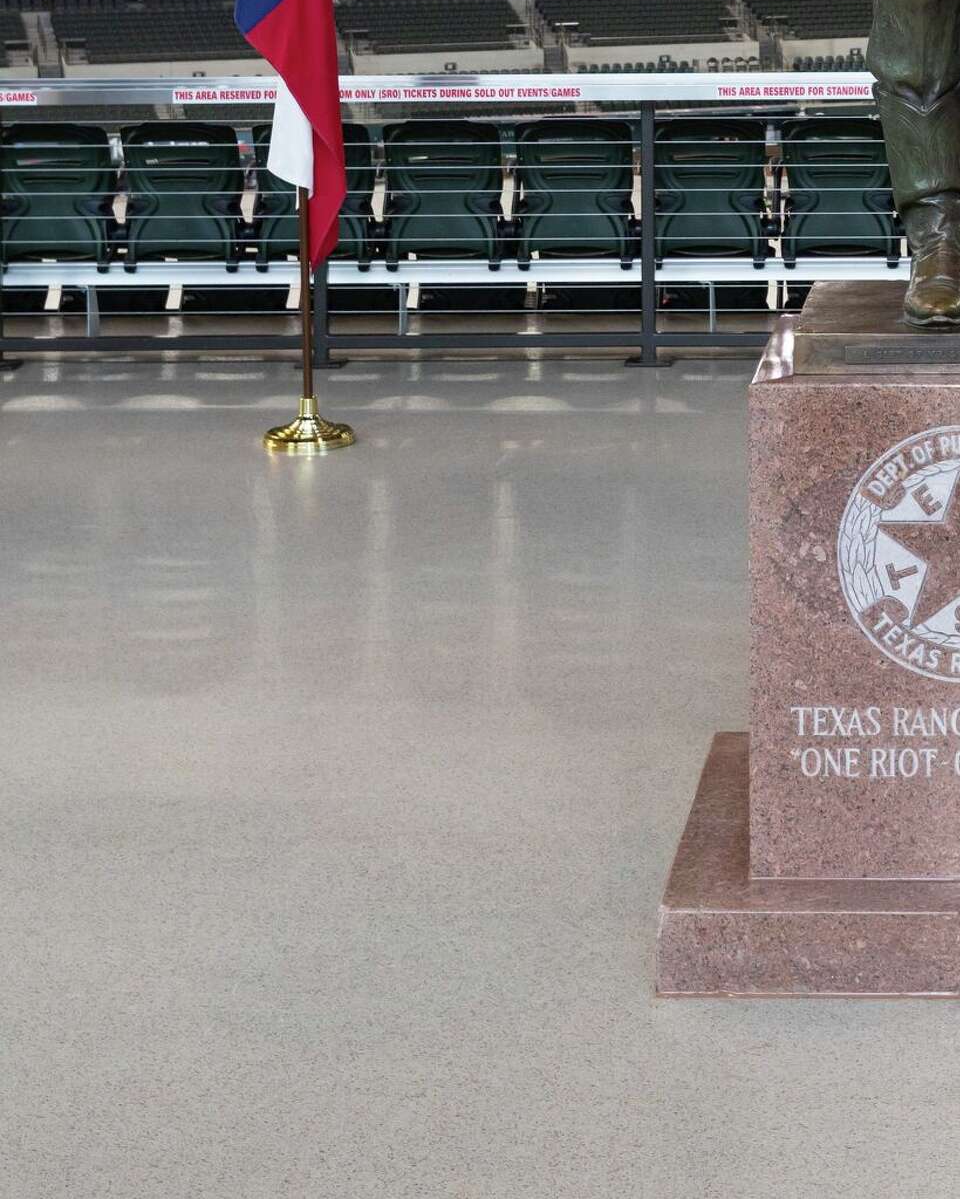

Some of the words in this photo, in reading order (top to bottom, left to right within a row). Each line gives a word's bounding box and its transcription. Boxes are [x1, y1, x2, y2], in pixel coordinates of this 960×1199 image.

[175, 90, 194, 100] THIS
[195, 90, 217, 100] AREA
[219, 90, 261, 100] RESERVED
[339, 89, 352, 99] OM
[355, 89, 376, 99] ONLY
[379, 88, 400, 100] (SRO)
[403, 88, 437, 98] TICKETS
[440, 88, 472, 98] DURING
[474, 88, 496, 98] SOLD
[498, 88, 515, 98] OUT
[718, 87, 737, 96] THIS
[738, 87, 761, 96] AREA
[763, 86, 805, 96] RESERVED
[807, 86, 824, 96] FOR
[826, 86, 869, 96] STANDING
[867, 453, 913, 497] DEPT.
[912, 441, 934, 464] OF
[873, 612, 941, 669] TEXAS
[791, 706, 881, 737] TEXAS
[870, 748, 938, 778] RIOT
